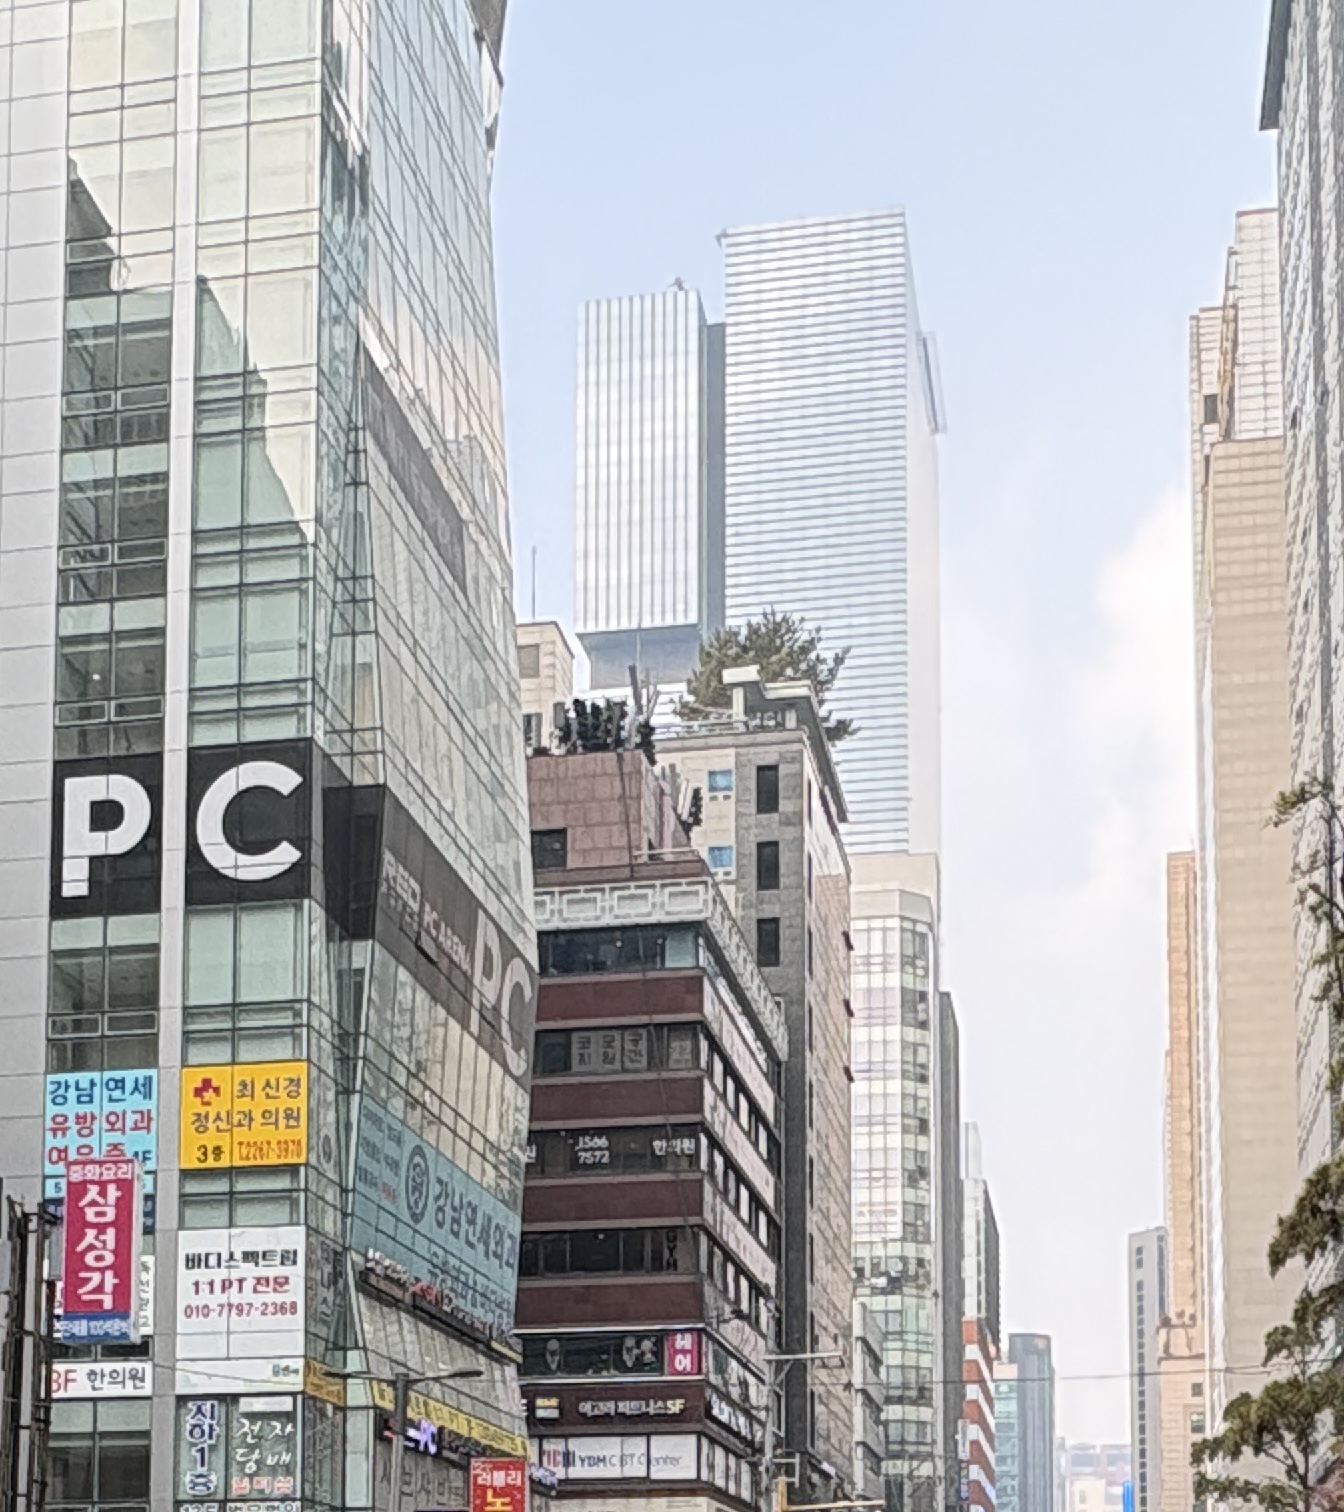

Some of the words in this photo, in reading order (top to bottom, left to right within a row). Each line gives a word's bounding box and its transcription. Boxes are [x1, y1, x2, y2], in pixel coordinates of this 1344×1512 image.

[61, 761, 304, 898] PC
[469, 907, 534, 1077] PC
[49, 1077, 154, 1106] 강남연세
[47, 1107, 154, 1139] 유방외과
[76, 1183, 122, 1311] 삼성각
[221, 1277, 247, 1295] PT
[86, 1367, 147, 1393] 한의원
[235, 1417, 295, 1444] 전자
[185, 1399, 220, 1496] 지하1층
[234, 1448, 293, 1475] 담배
